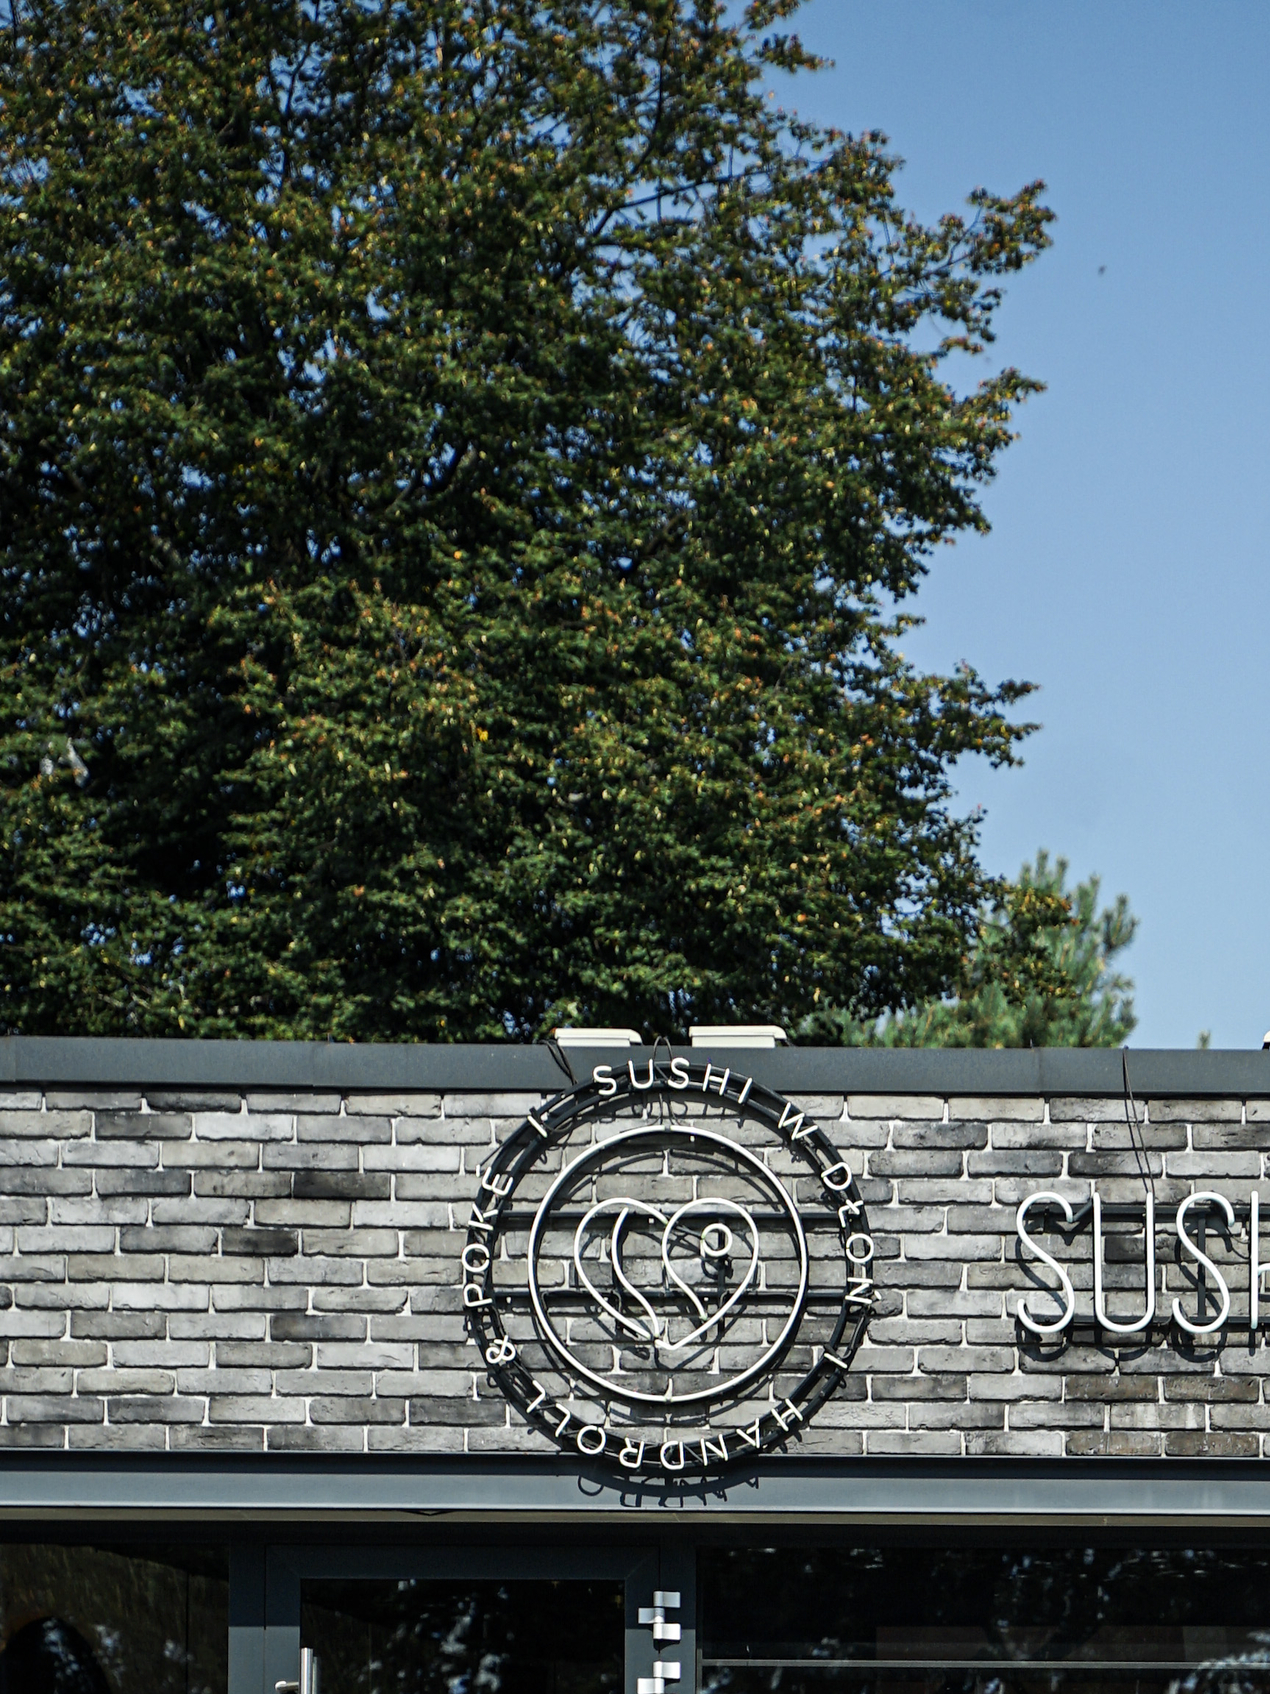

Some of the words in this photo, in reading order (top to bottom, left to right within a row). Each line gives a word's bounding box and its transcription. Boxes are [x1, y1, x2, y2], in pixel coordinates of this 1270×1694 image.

[593, 1058, 754, 1104] SUSHI
[777, 1102, 819, 1141] W
[821, 1161, 882, 1305] DŁOŃ
[485, 1334, 517, 1365] &
[526, 1379, 804, 1470] HANDROLL
